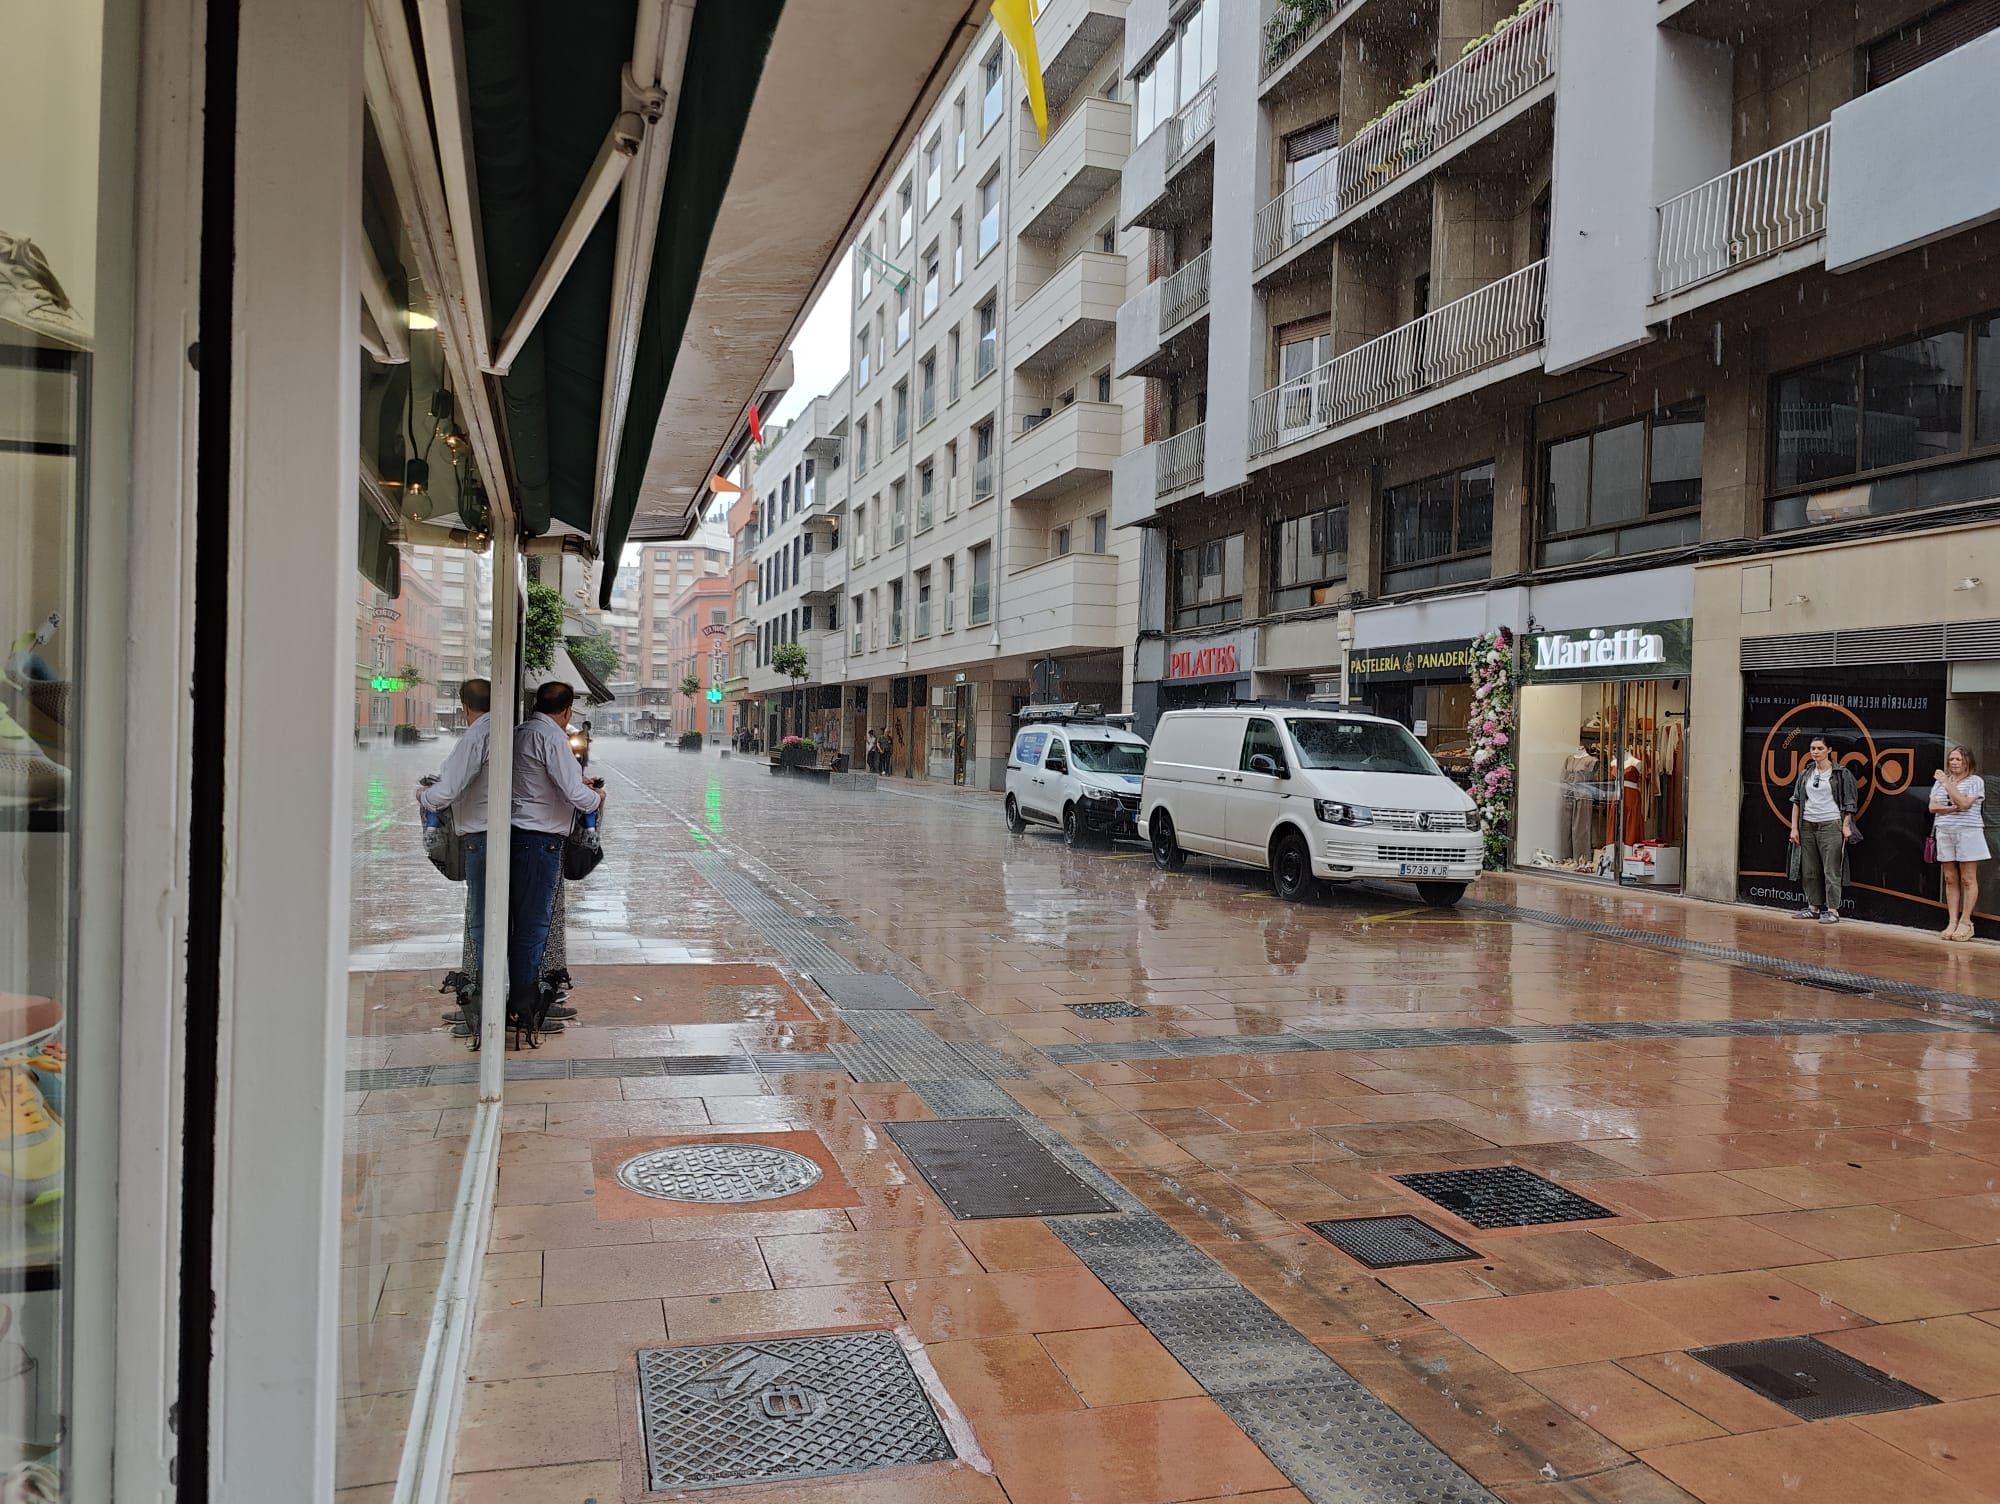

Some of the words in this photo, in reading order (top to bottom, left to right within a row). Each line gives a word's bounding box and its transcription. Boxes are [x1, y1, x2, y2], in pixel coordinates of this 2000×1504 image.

[1535, 629, 1667, 670] Marietta
[1169, 644, 1236, 679] PILATES
[1350, 653, 1401, 674] PASTELERÍA
[1325, 682, 1330, 693] 9
[1406, 865, 1429, 875] 5739
[1432, 866, 1448, 876] KJR
